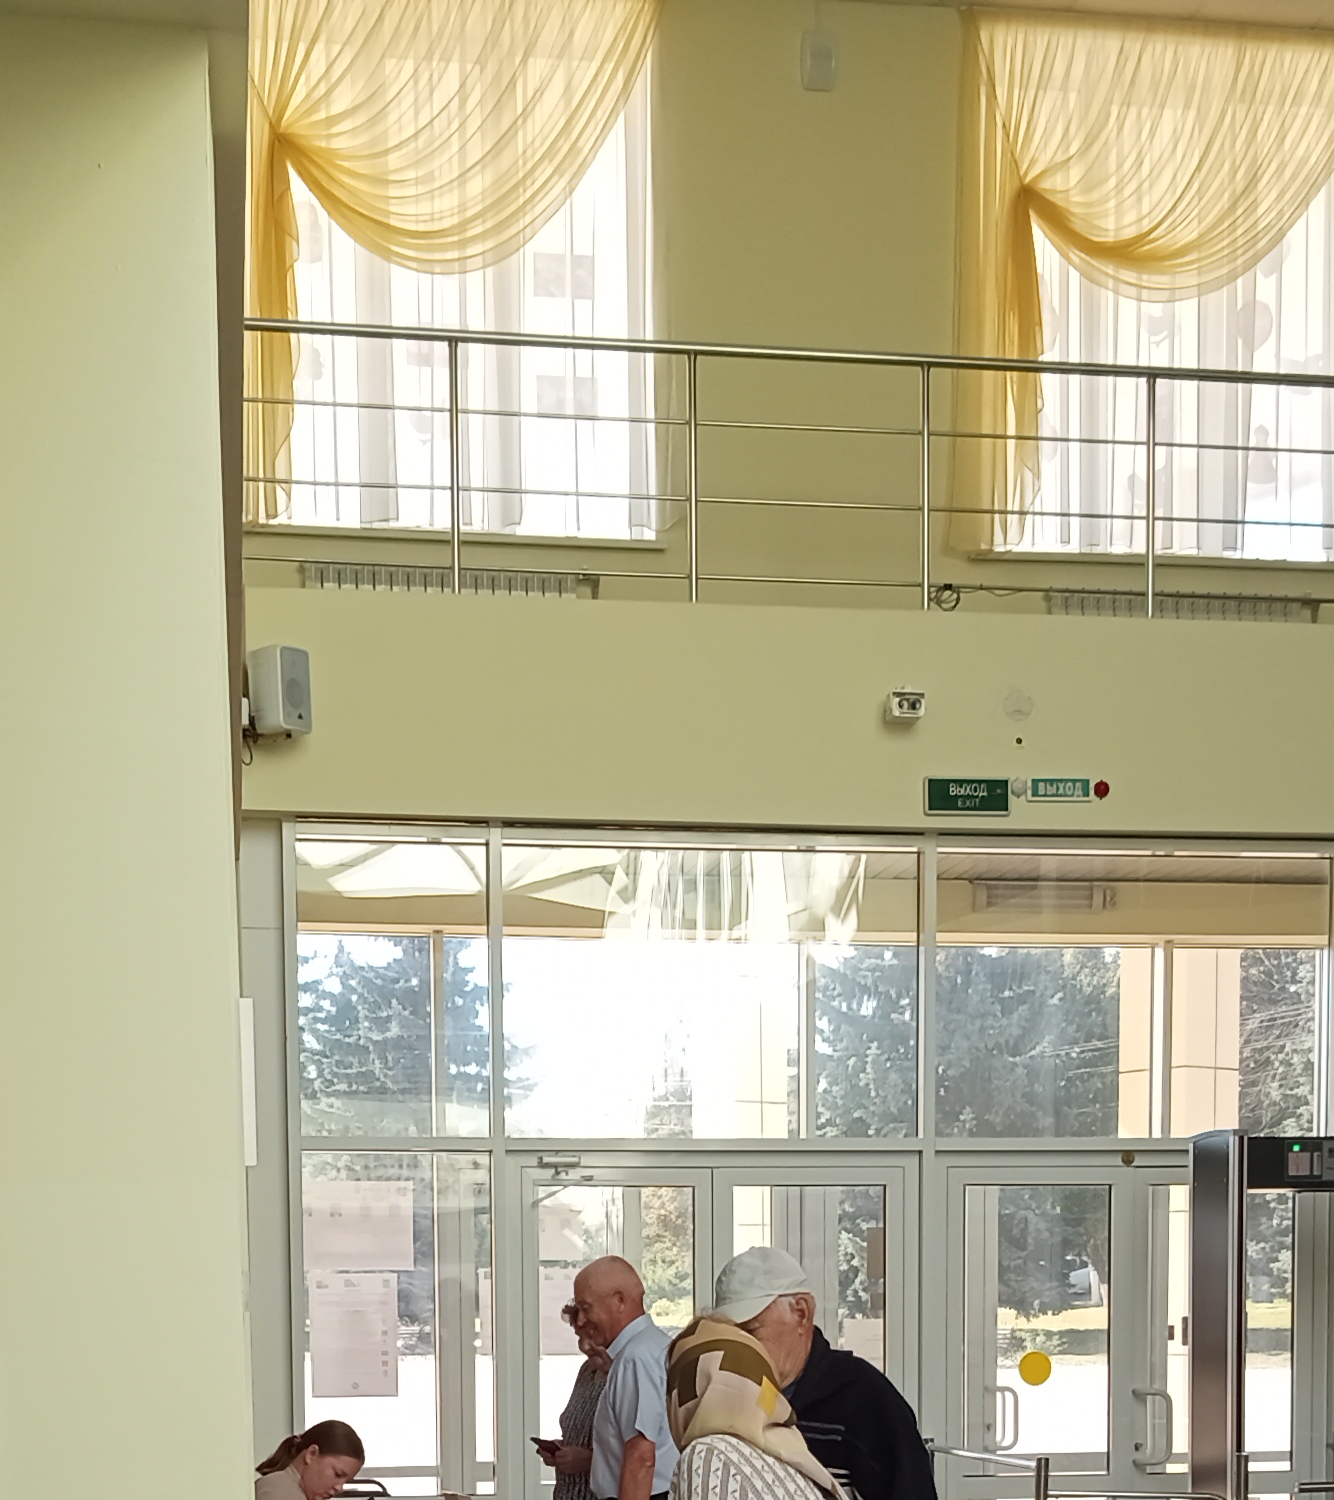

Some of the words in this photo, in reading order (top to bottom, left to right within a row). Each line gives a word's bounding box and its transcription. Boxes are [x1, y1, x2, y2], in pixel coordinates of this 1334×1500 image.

[949, 782, 987, 797] ВЫХОД
[1038, 781, 1083, 797] ВЫХОД
[957, 798, 980, 807] EXIT
